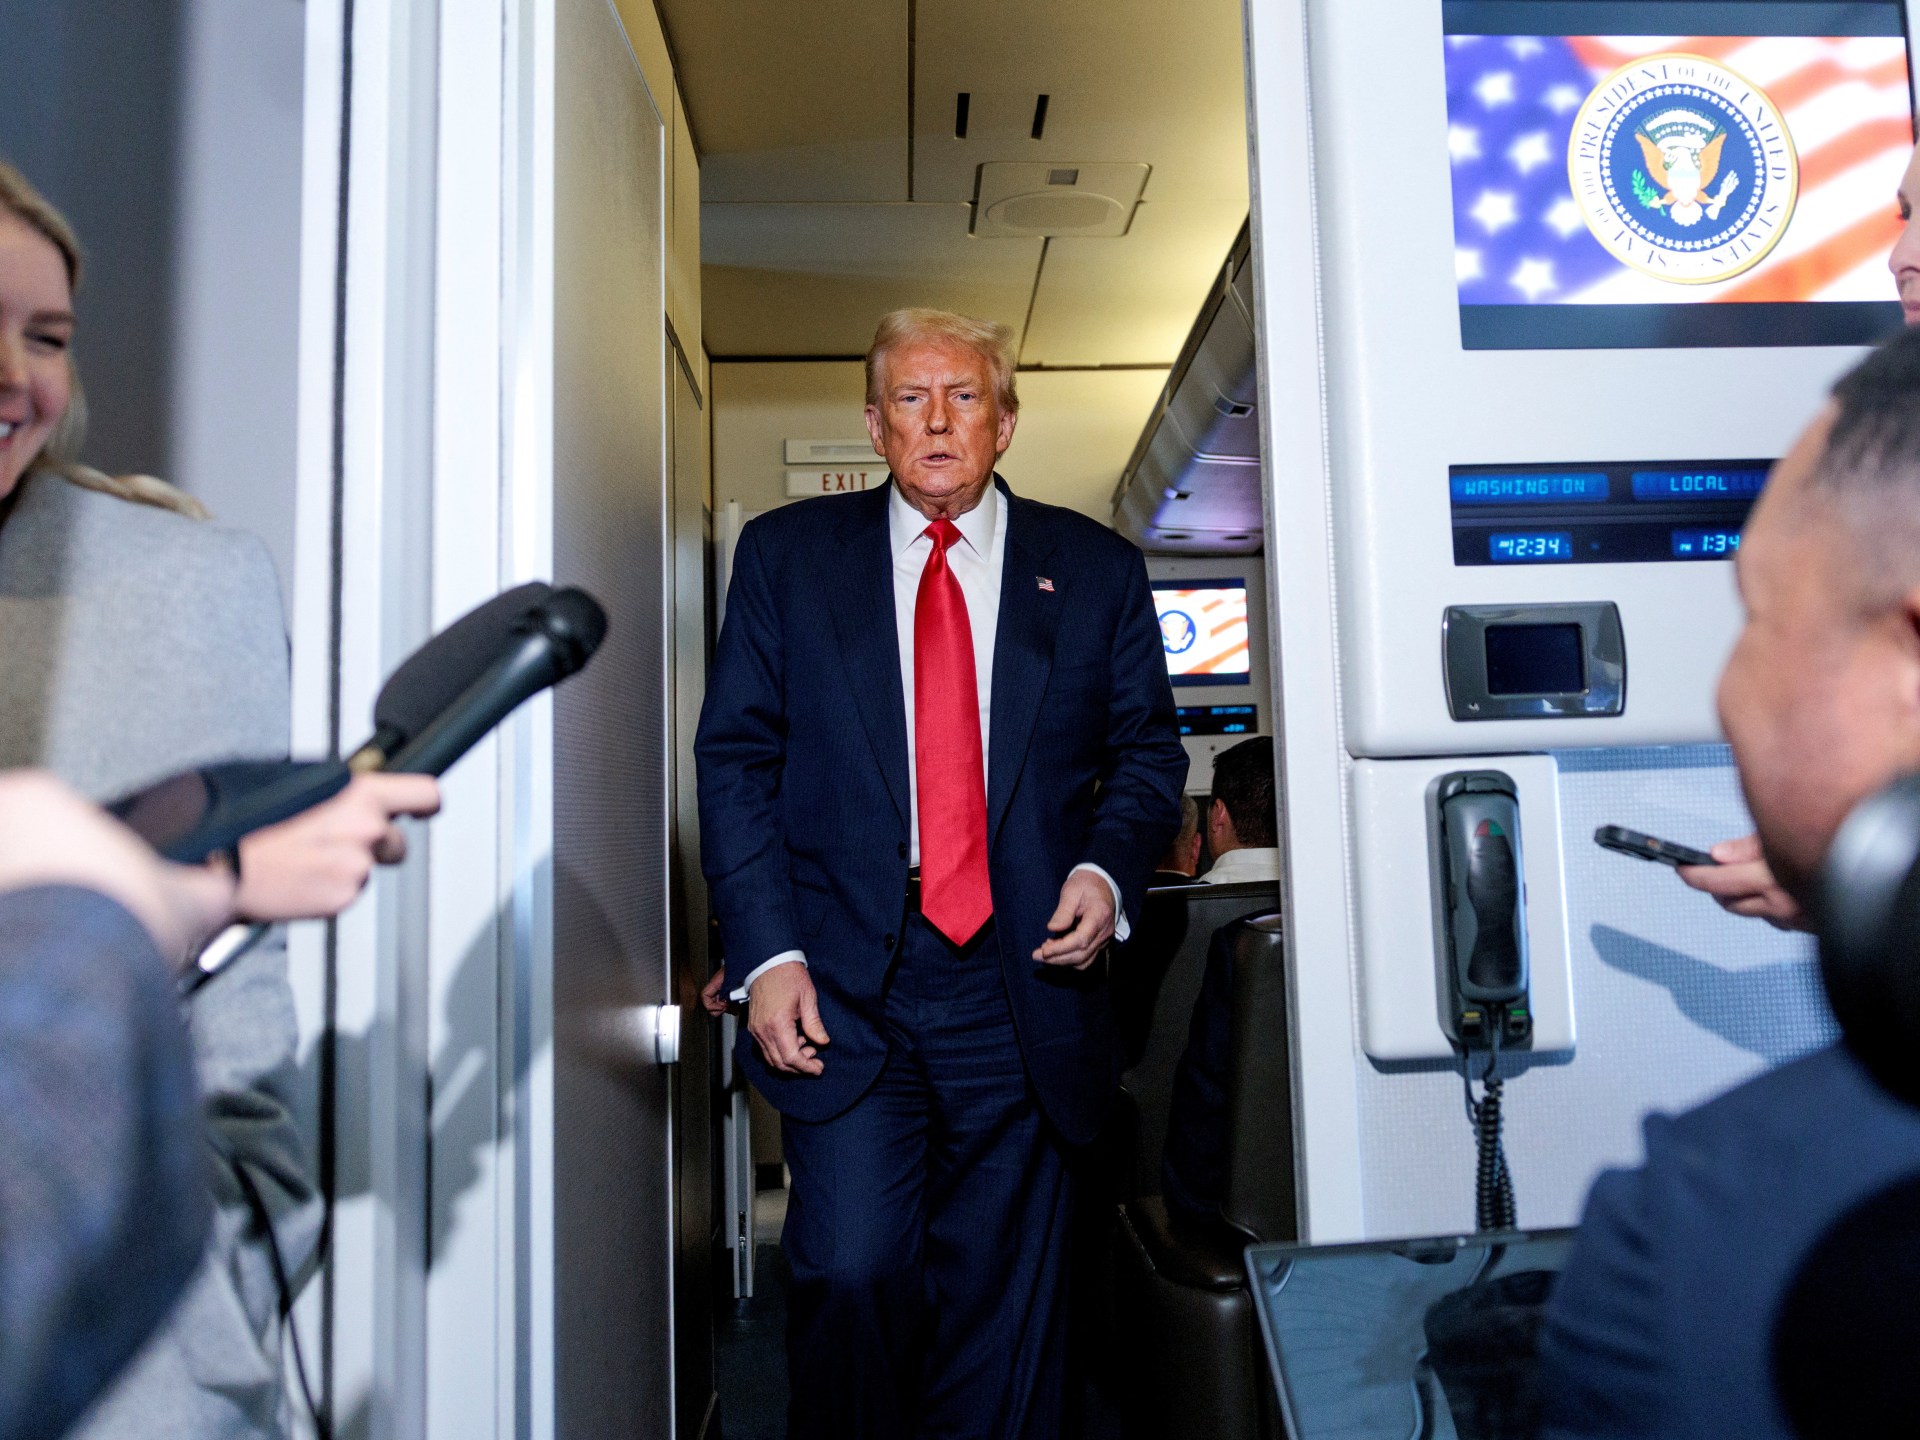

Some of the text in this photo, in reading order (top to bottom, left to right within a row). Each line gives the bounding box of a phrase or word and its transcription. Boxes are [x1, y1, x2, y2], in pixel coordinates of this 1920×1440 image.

[1579, 64, 1669, 159] PRESIDENT
[1740, 91, 1787, 180] UNITED
[1711, 204, 1779, 265] STATES
[822, 472, 868, 491] EXIT
[1464, 478, 1585, 496] WASHINGON
[1669, 475, 1728, 491] LOCAL
[1508, 538, 1560, 556] 12:34
[1702, 534, 1740, 552] 1:34
